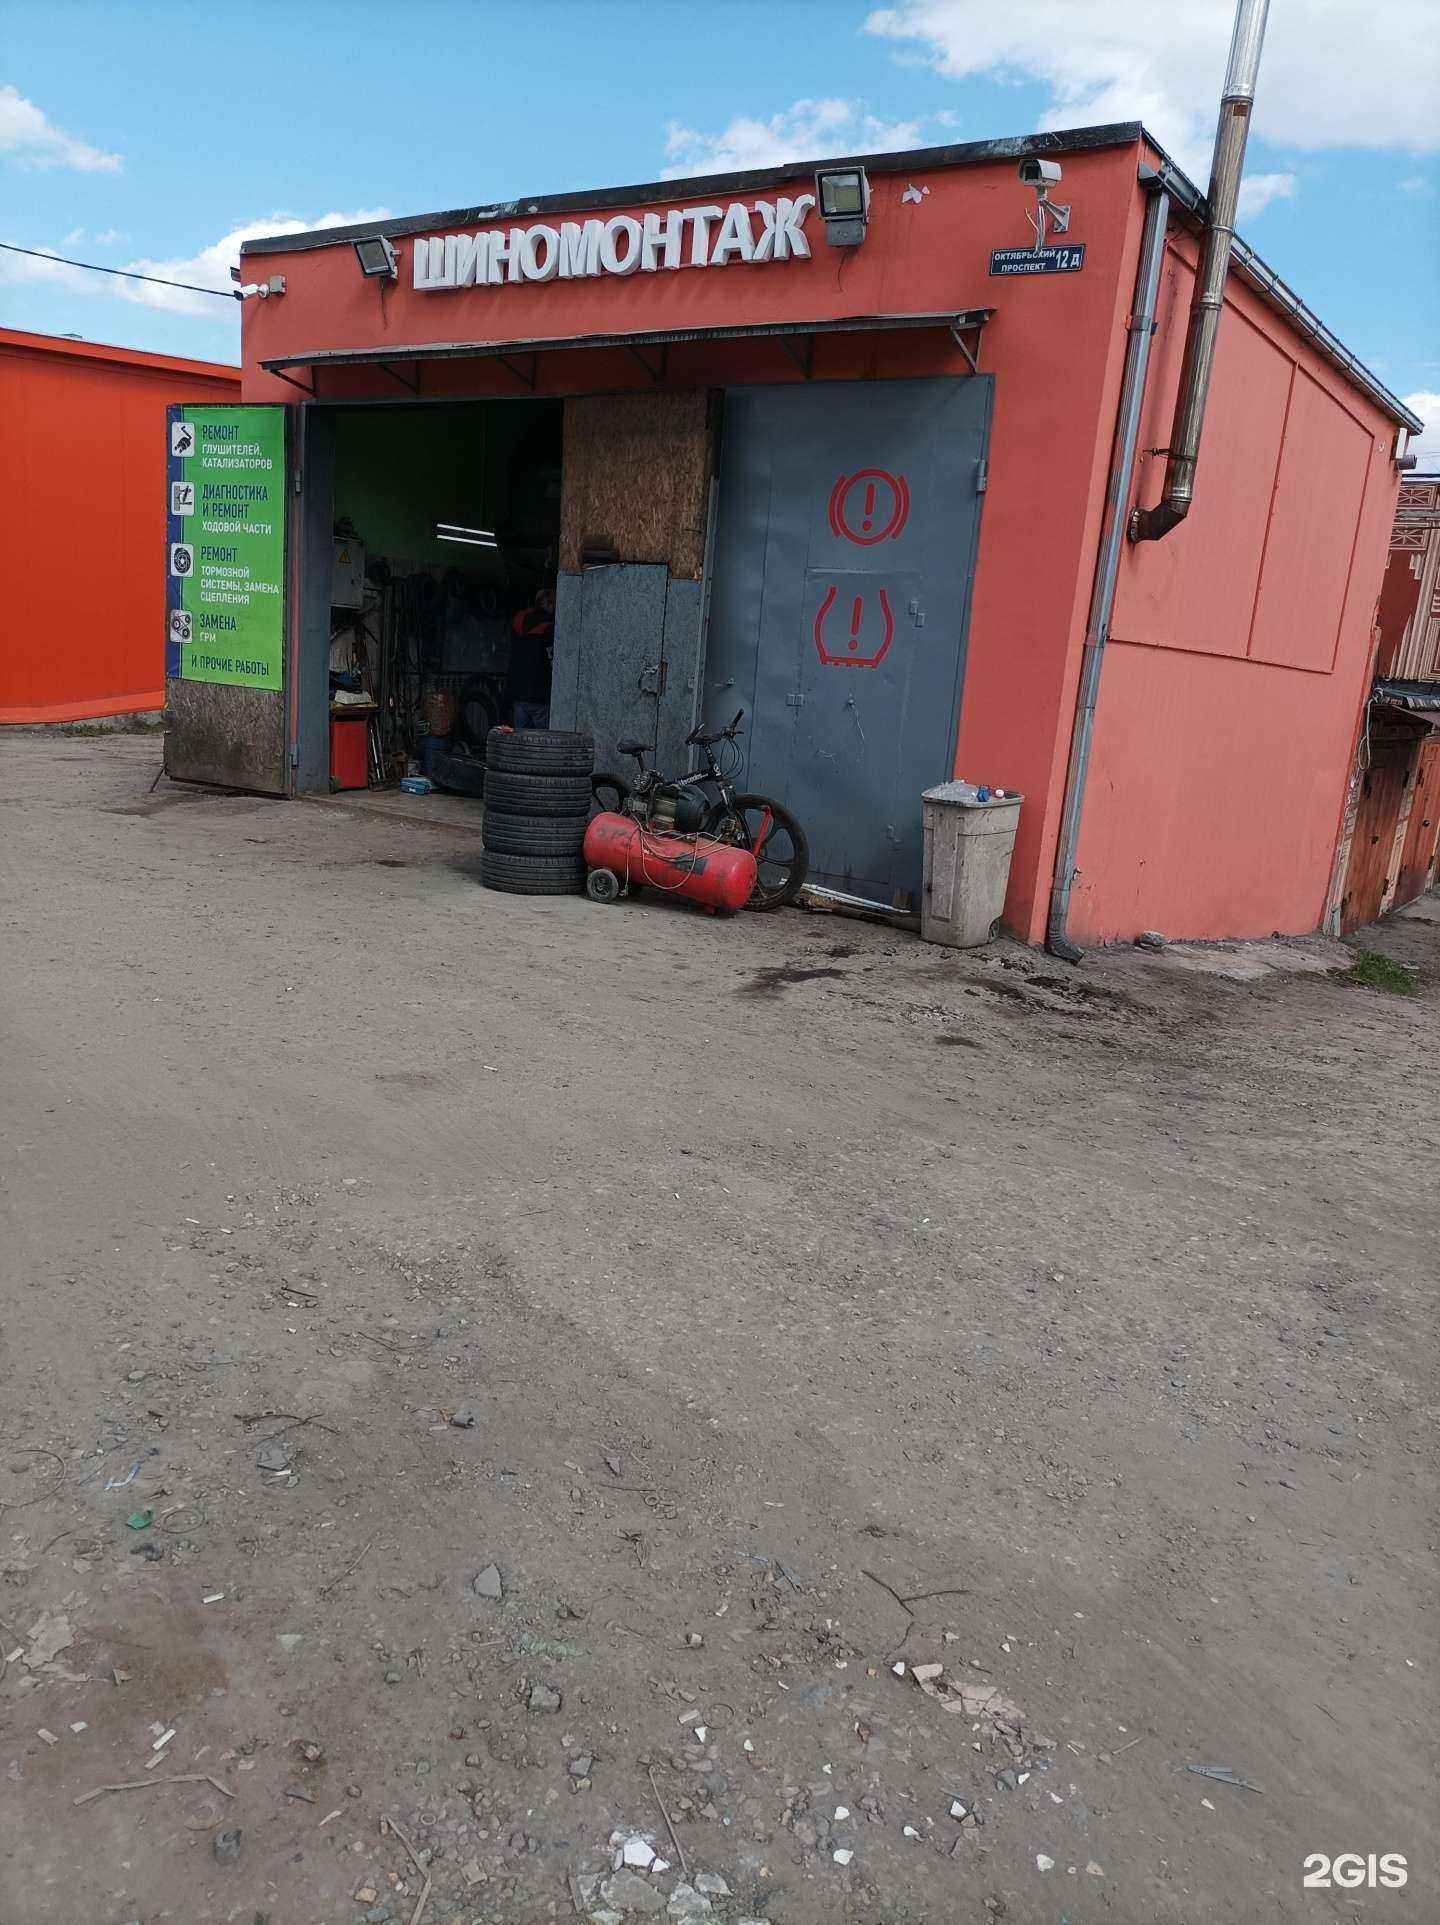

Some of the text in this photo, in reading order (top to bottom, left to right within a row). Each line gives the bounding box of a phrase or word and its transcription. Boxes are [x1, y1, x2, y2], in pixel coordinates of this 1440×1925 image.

[413, 194, 816, 290] ШИНОМОНТАЖ
[994, 249, 1056, 261] ОКТЯБРЬСКИЙ
[1056, 250, 1069, 269] 12
[1001, 262, 1046, 272] ПРОСПЕКТ
[202, 425, 240, 441] РЕМОНТ
[202, 443, 262, 456] ГЛУШИТЕЛЕЙ,
[202, 458, 273, 470] КАТАЛИЗАТОРОВ
[202, 484, 269, 501] ДИАГНОСТИКА
[202, 503, 250, 519] И РЕМОНТ
[202, 520, 272, 535] ХОДОВОЙ ЧАСТИ
[201, 546, 238, 563] РЕМОНТ
[202, 565, 250, 579] ТОРМОЗНОЙ
[200, 579, 280, 594] СИСТЕМЫ, ЗАМЕНА
[200, 591, 250, 605] СЦЕПЛЕНИЯ
[200, 613, 237, 631] ЗАМЕНА
[200, 631, 216, 642] ГРМ
[191, 654, 269, 675] И ПРОЧИЕ РАБОТЫ
